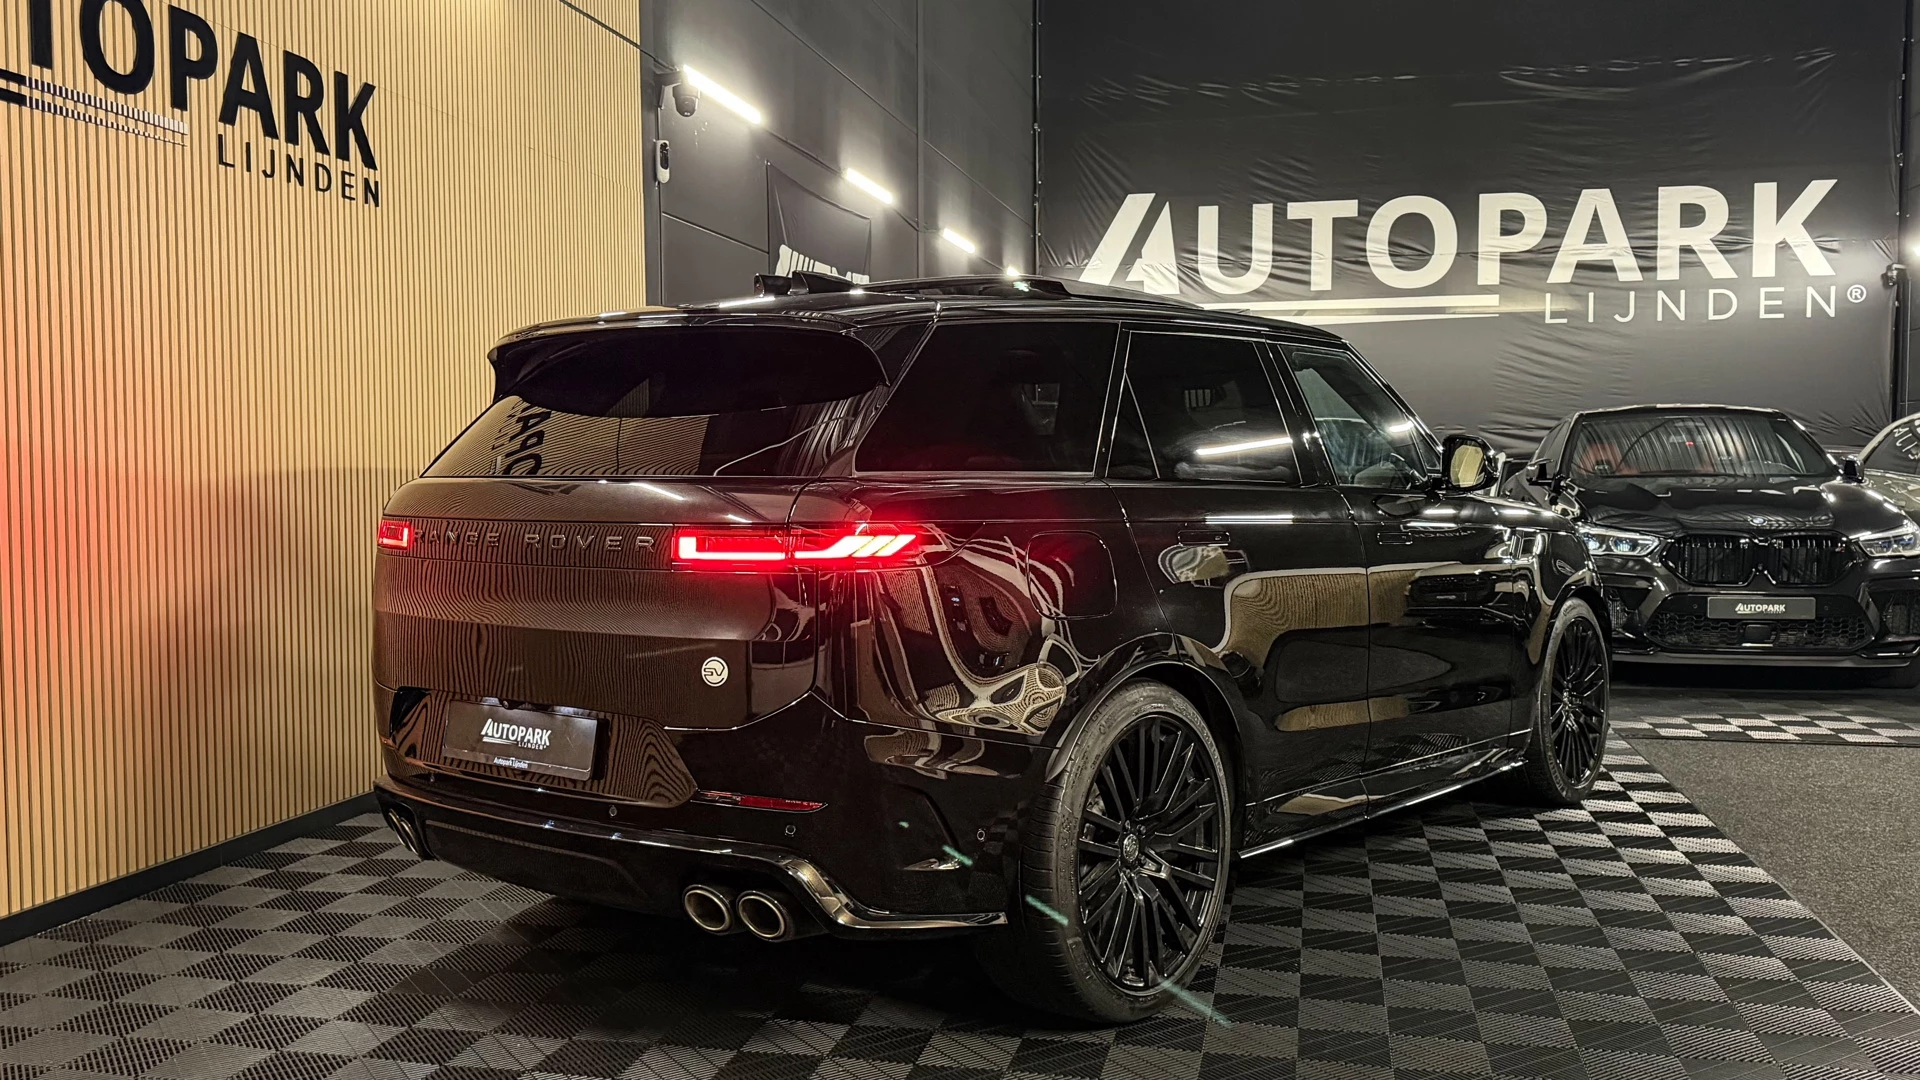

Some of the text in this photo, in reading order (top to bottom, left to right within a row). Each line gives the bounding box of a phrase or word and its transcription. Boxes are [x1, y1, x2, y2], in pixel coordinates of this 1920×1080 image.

[217, 133, 380, 208] LIJNDEN
[1079, 178, 1838, 295] AUTOPARK
[413, 528, 656, 553] RANGE ROVER
[1735, 602, 1786, 612] AUTOPARK
[480, 718, 552, 746] AUTOPARK
